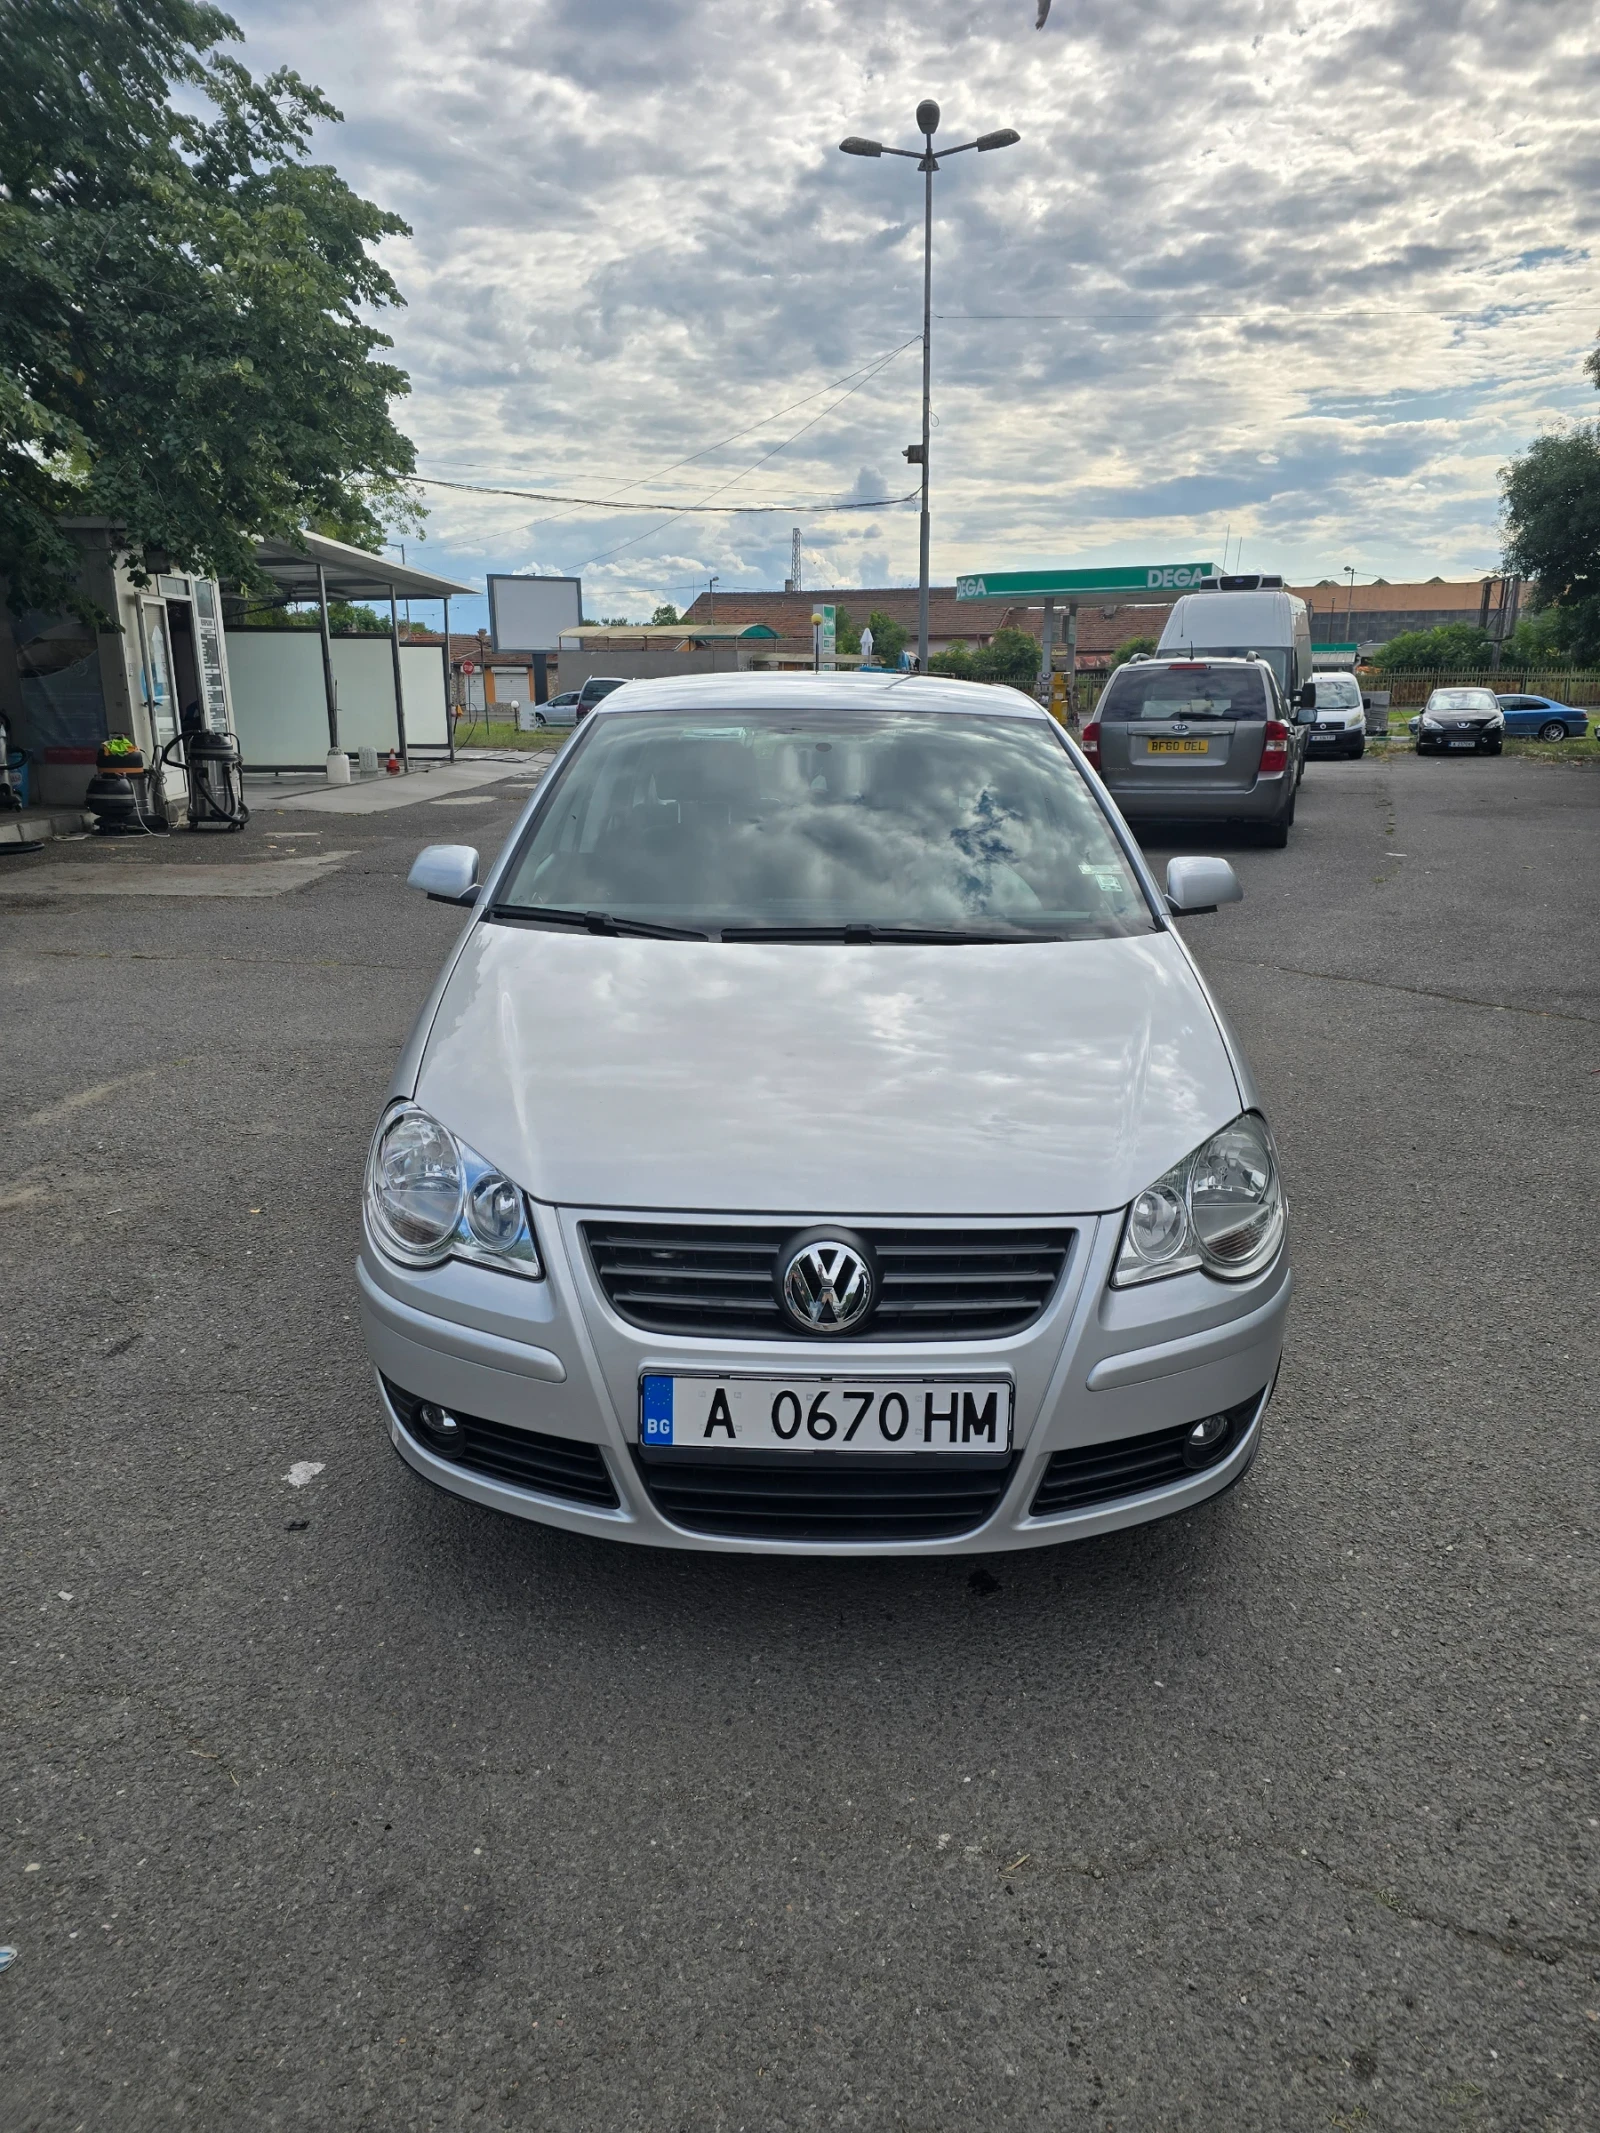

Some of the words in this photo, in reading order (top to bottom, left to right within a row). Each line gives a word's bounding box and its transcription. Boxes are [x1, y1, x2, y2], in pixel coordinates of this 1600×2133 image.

[1147, 567, 1203, 588] DEGA
[957, 578, 987, 598] DEGA
[1151, 741, 1180, 751] BF60
[703, 1387, 737, 1439] A
[647, 1419, 671, 1434] BG
